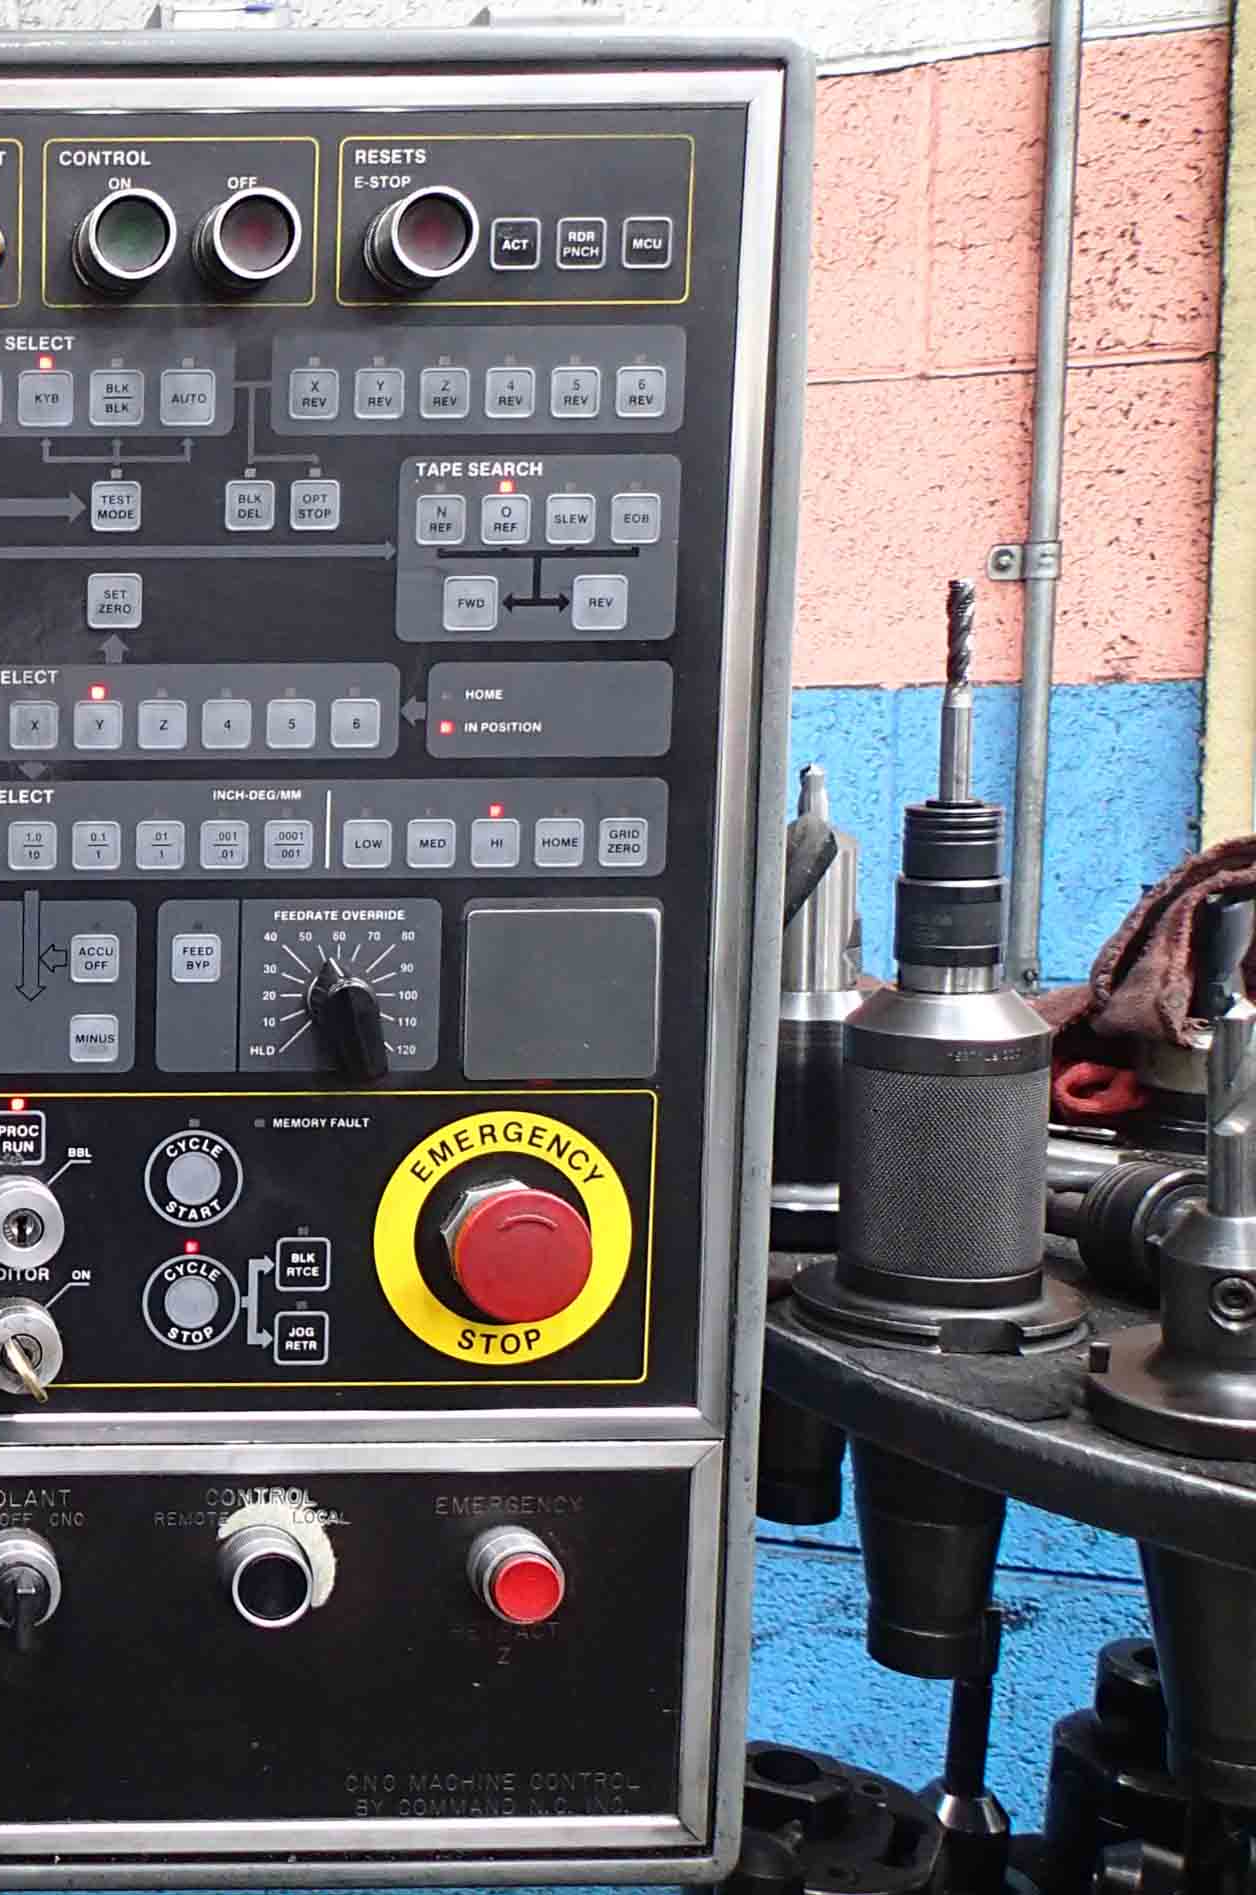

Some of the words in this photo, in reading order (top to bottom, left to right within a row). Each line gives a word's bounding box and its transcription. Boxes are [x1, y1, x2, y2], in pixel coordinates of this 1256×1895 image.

[59, 151, 151, 166] CONTROL
[355, 150, 426, 164] RESETS
[108, 178, 131, 190] ON
[227, 177, 257, 190] OFF
[354, 176, 411, 189] E-STOP
[568, 232, 594, 242] RDR
[502, 239, 528, 251] ACT
[632, 238, 662, 249] MCU
[563, 246, 599, 257] PNCH
[5, 336, 75, 350] SELECT
[105, 383, 129, 394] BLK
[34, 393, 59, 404] KYB
[171, 393, 207, 404] AUTO
[301, 397, 327, 407] REV
[367, 396, 392, 407] REV
[432, 396, 457, 407] REV
[498, 396, 523, 406] REV
[563, 395, 588, 406] REV
[628, 395, 654, 406] REV
[105, 403, 129, 413] BLK
[416, 463, 463, 477] TAPE
[467, 462, 543, 476] SEARCH
[101, 495, 132, 506] TEST
[238, 494, 262, 505] BLK
[302, 494, 328, 505] OPT
[97, 509, 135, 520] MODE
[237, 508, 263, 519] DEL
[298, 508, 331, 519] STOP
[554, 514, 588, 524] SLEW
[623, 514, 649, 524] EOB
[429, 523, 453, 532] REF
[494, 523, 518, 532] REF
[103, 590, 127, 600] SET
[458, 599, 485, 609] FWD
[589, 598, 613, 608] REV
[98, 604, 132, 614] ZERO
[465, 689, 503, 700] HOME
[464, 722, 478, 733] IN
[480, 722, 541, 733] POSITION
[212, 790, 302, 801] INCH-DEG/MM
[609, 830, 640, 840] GRID
[355, 839, 382, 849] LOW
[419, 839, 446, 849] MED
[542, 837, 579, 848] HOME
[607, 843, 640, 854] ZERO
[274, 910, 338, 921] FEEDRATE
[341, 910, 406, 921] OVERRIDE
[78, 947, 113, 957] ACCU
[182, 946, 214, 956] FEED
[84, 961, 108, 971] OFF
[186, 961, 210, 971] BYP
[398, 990, 418, 1000] 100
[262, 1017, 275, 1027] 10
[398, 1017, 417, 1027] 110
[75, 1034, 115, 1044] MINUS
[249, 1046, 275, 1056] HLD
[397, 1045, 416, 1055] 120
[272, 1118, 327, 1129] MEMORY
[330, 1118, 370, 1128] FAULT
[2, 1141, 34, 1153] RUN
[67, 1147, 92, 1158] BBL
[165, 1137, 224, 1159] CYCLE
[410, 1121, 606, 1184] EMERGENCY
[165, 1199, 222, 1221] START
[291, 1253, 316, 1264] BLK
[71, 1270, 91, 1280] ON
[163, 1261, 222, 1283] CYCLE
[286, 1266, 320, 1277] RTCE
[167, 1326, 214, 1344] STOP
[289, 1327, 315, 1338] JOG
[285, 1340, 317, 1351] RETR
[457, 1328, 541, 1355] STOP
[206, 1487, 313, 1506] CONTROL
[434, 1495, 584, 1516] EMERGENCY
[50, 1512, 85, 1527] CNC
[153, 1511, 229, 1527] REMOTE
[291, 1510, 349, 1525] LOCAL
[409, 1773, 516, 1792] MACHINE
[529, 1772, 641, 1791] CONTROL
